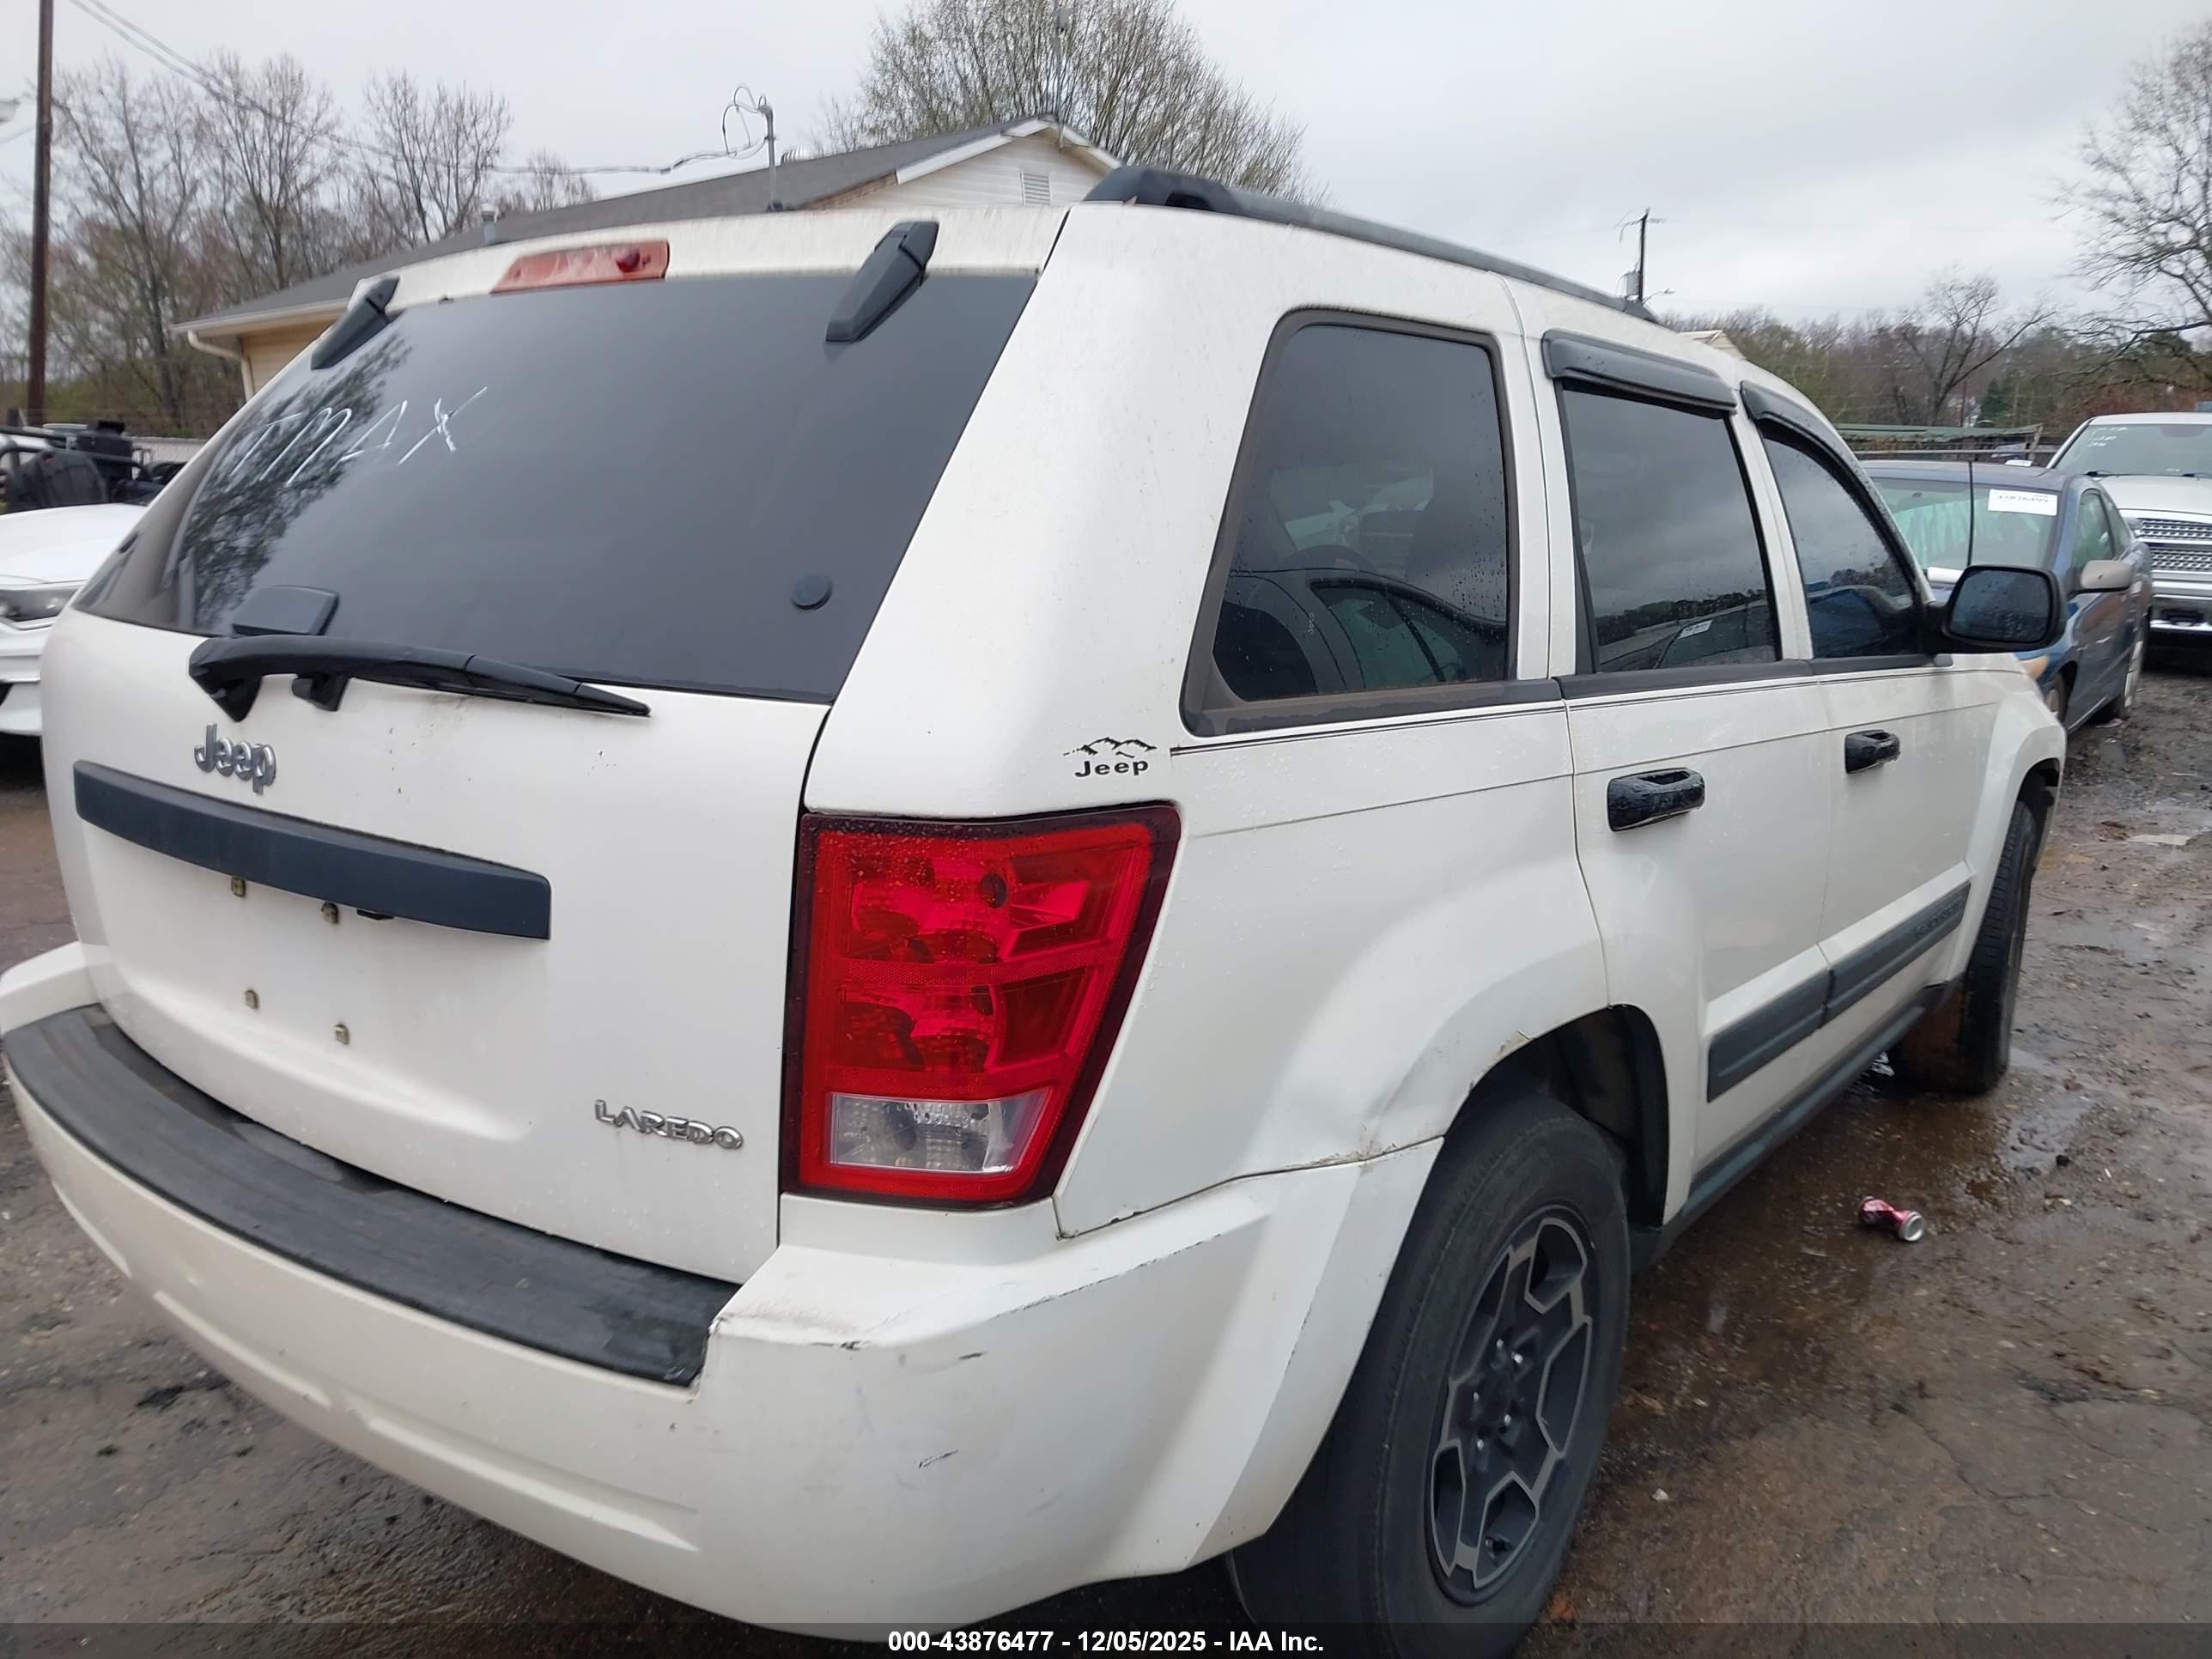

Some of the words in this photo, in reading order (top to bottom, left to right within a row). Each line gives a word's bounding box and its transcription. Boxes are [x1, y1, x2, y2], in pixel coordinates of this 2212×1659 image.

[194, 722, 276, 796] Jeep
[1073, 760, 1149, 778] Jeep
[594, 1099, 744, 1151] LAREDO
